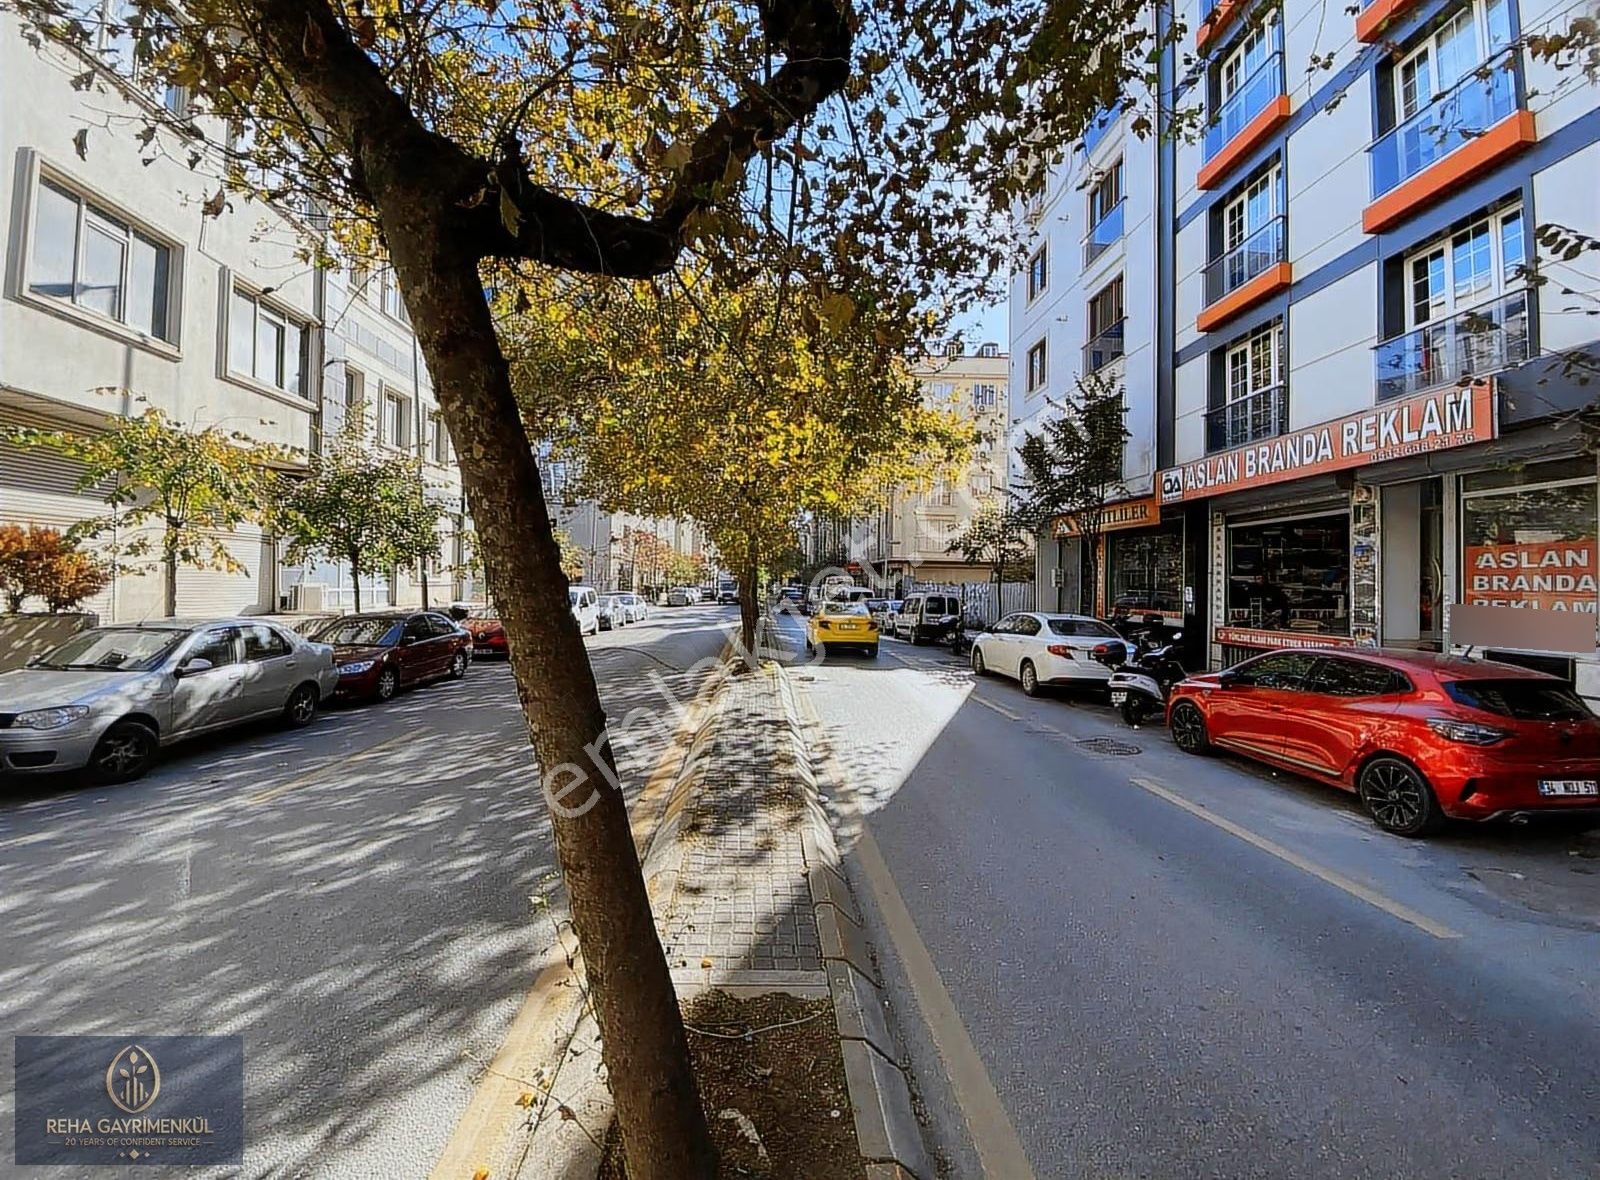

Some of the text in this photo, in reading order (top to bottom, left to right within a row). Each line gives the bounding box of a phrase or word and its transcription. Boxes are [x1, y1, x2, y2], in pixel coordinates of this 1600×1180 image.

[1186, 453, 1239, 491] ASLAN
[1245, 430, 1333, 478] BRANDA
[1342, 388, 1473, 456] REKLAM
[1478, 549, 1588, 569] ASLAN
[1473, 574, 1597, 592] BRANDA
